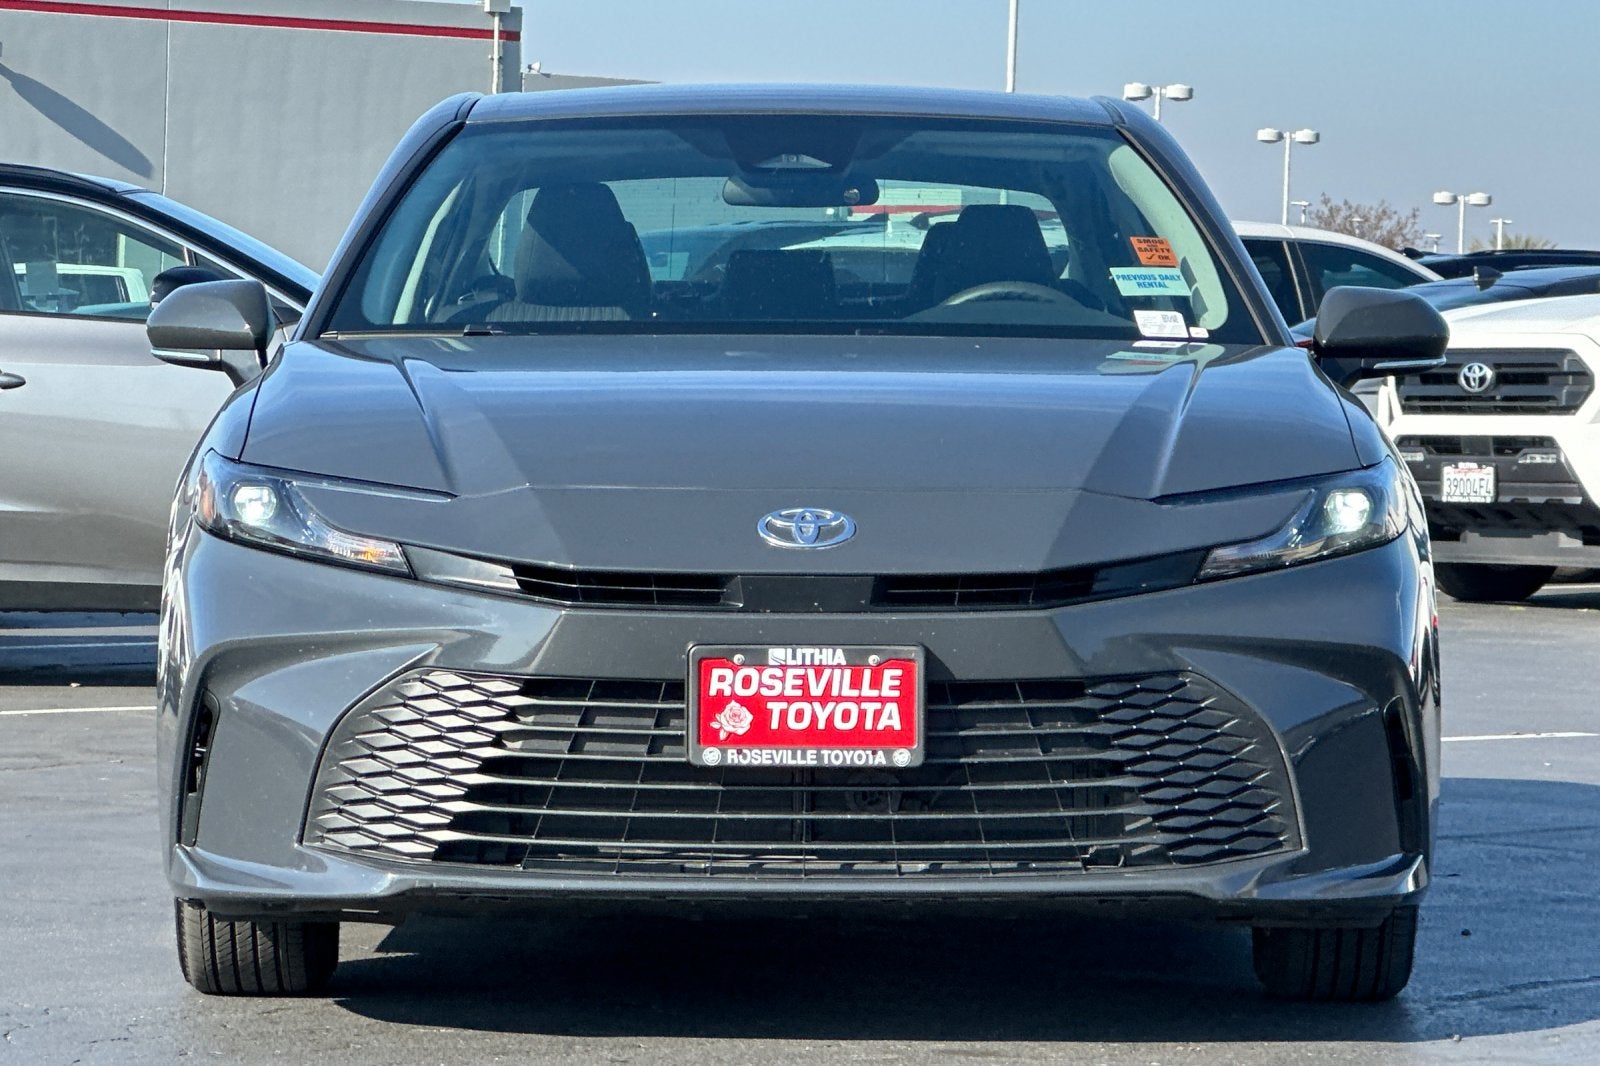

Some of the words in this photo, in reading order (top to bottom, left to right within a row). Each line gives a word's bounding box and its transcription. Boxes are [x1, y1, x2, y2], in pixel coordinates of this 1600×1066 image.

[1446, 477, 1491, 496] 39004F4
[787, 648, 847, 665] LITHIA
[708, 667, 904, 698] ROSEVILLE
[766, 701, 902, 731] TOYOTA
[727, 749, 818, 765] ROSEVILLE
[820, 750, 887, 765] TOYOTA
